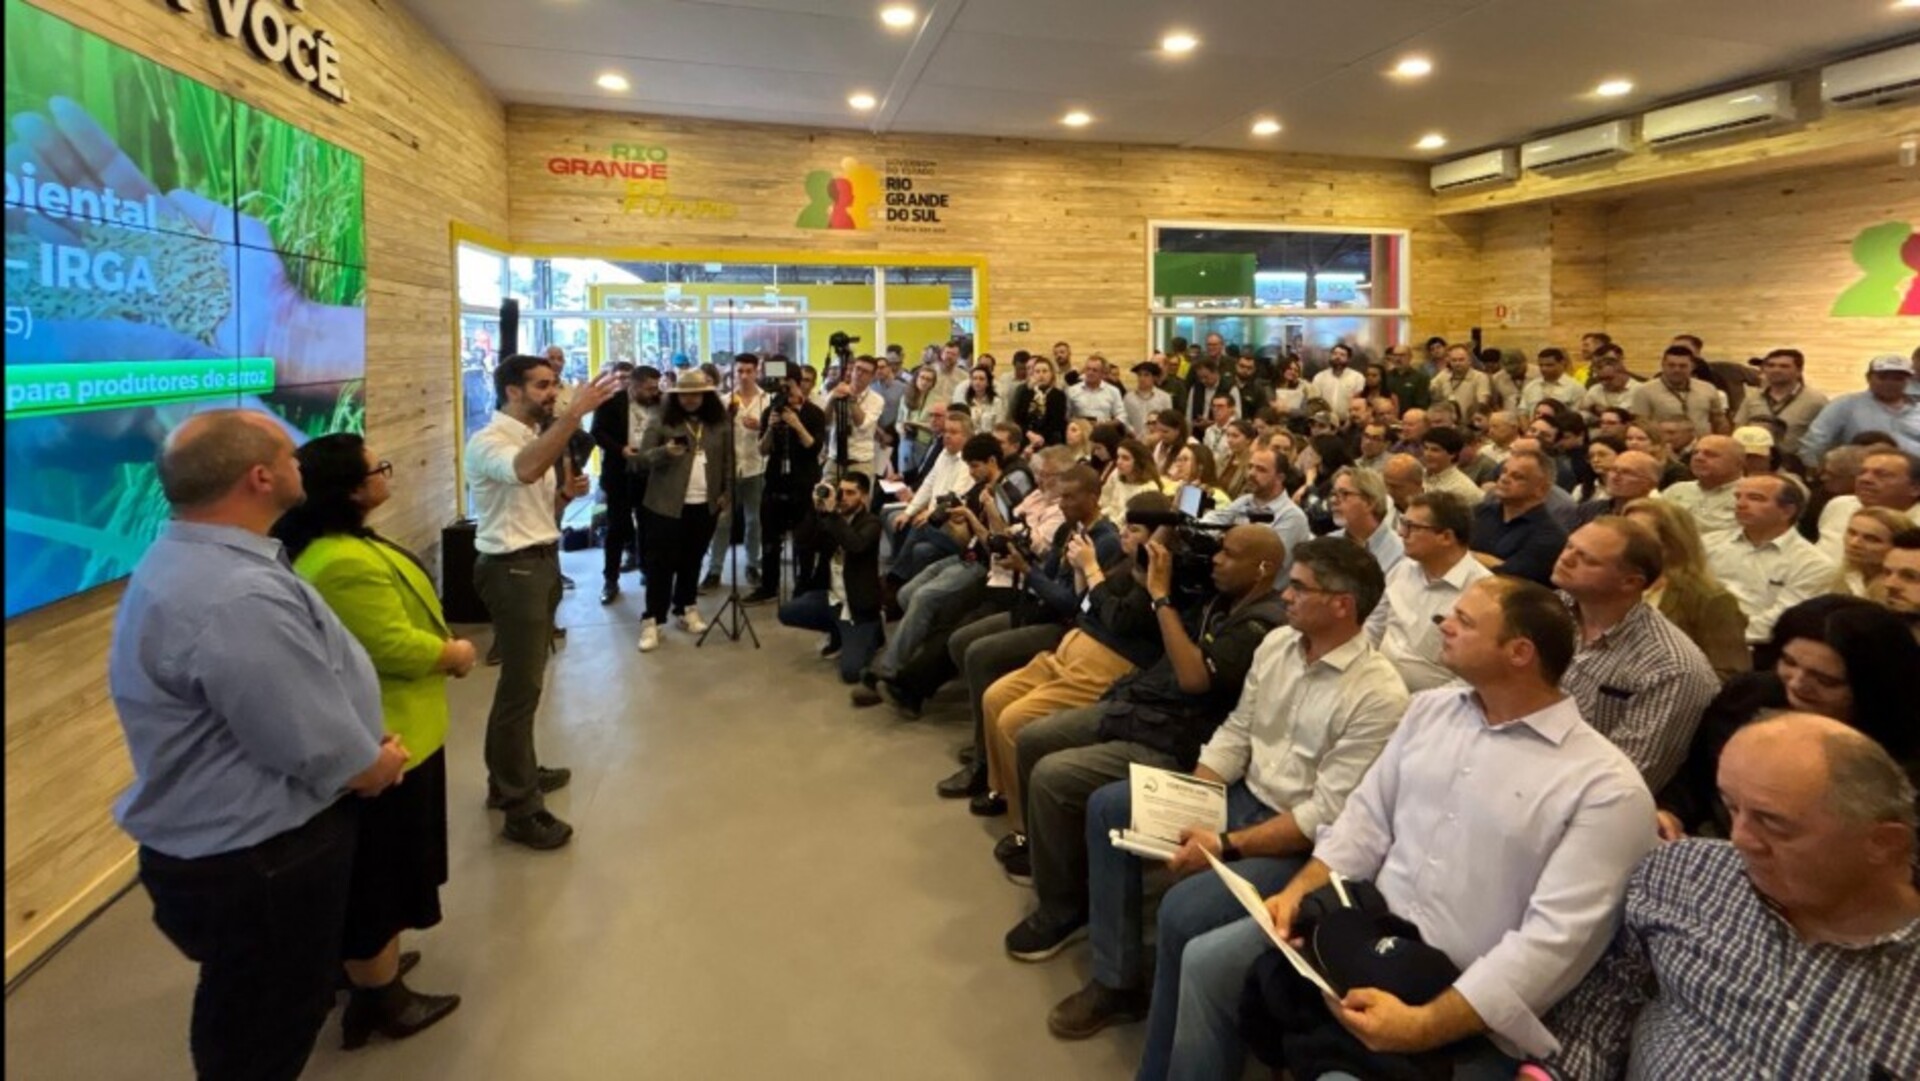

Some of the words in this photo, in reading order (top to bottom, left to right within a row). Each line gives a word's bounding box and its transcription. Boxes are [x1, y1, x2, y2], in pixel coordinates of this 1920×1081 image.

[612, 143, 668, 162] RIO
[547, 157, 668, 180] GRANDE
[886, 176, 912, 191] RIO
[886, 193, 949, 208] GRANDE
[887, 208, 909, 221] DO
[911, 208, 941, 222] SUL
[40, 242, 159, 296] IRGA
[6, 381, 71, 411] para
[77, 371, 198, 404] produtores
[202, 368, 225, 388] de
[227, 368, 267, 387] arroz
